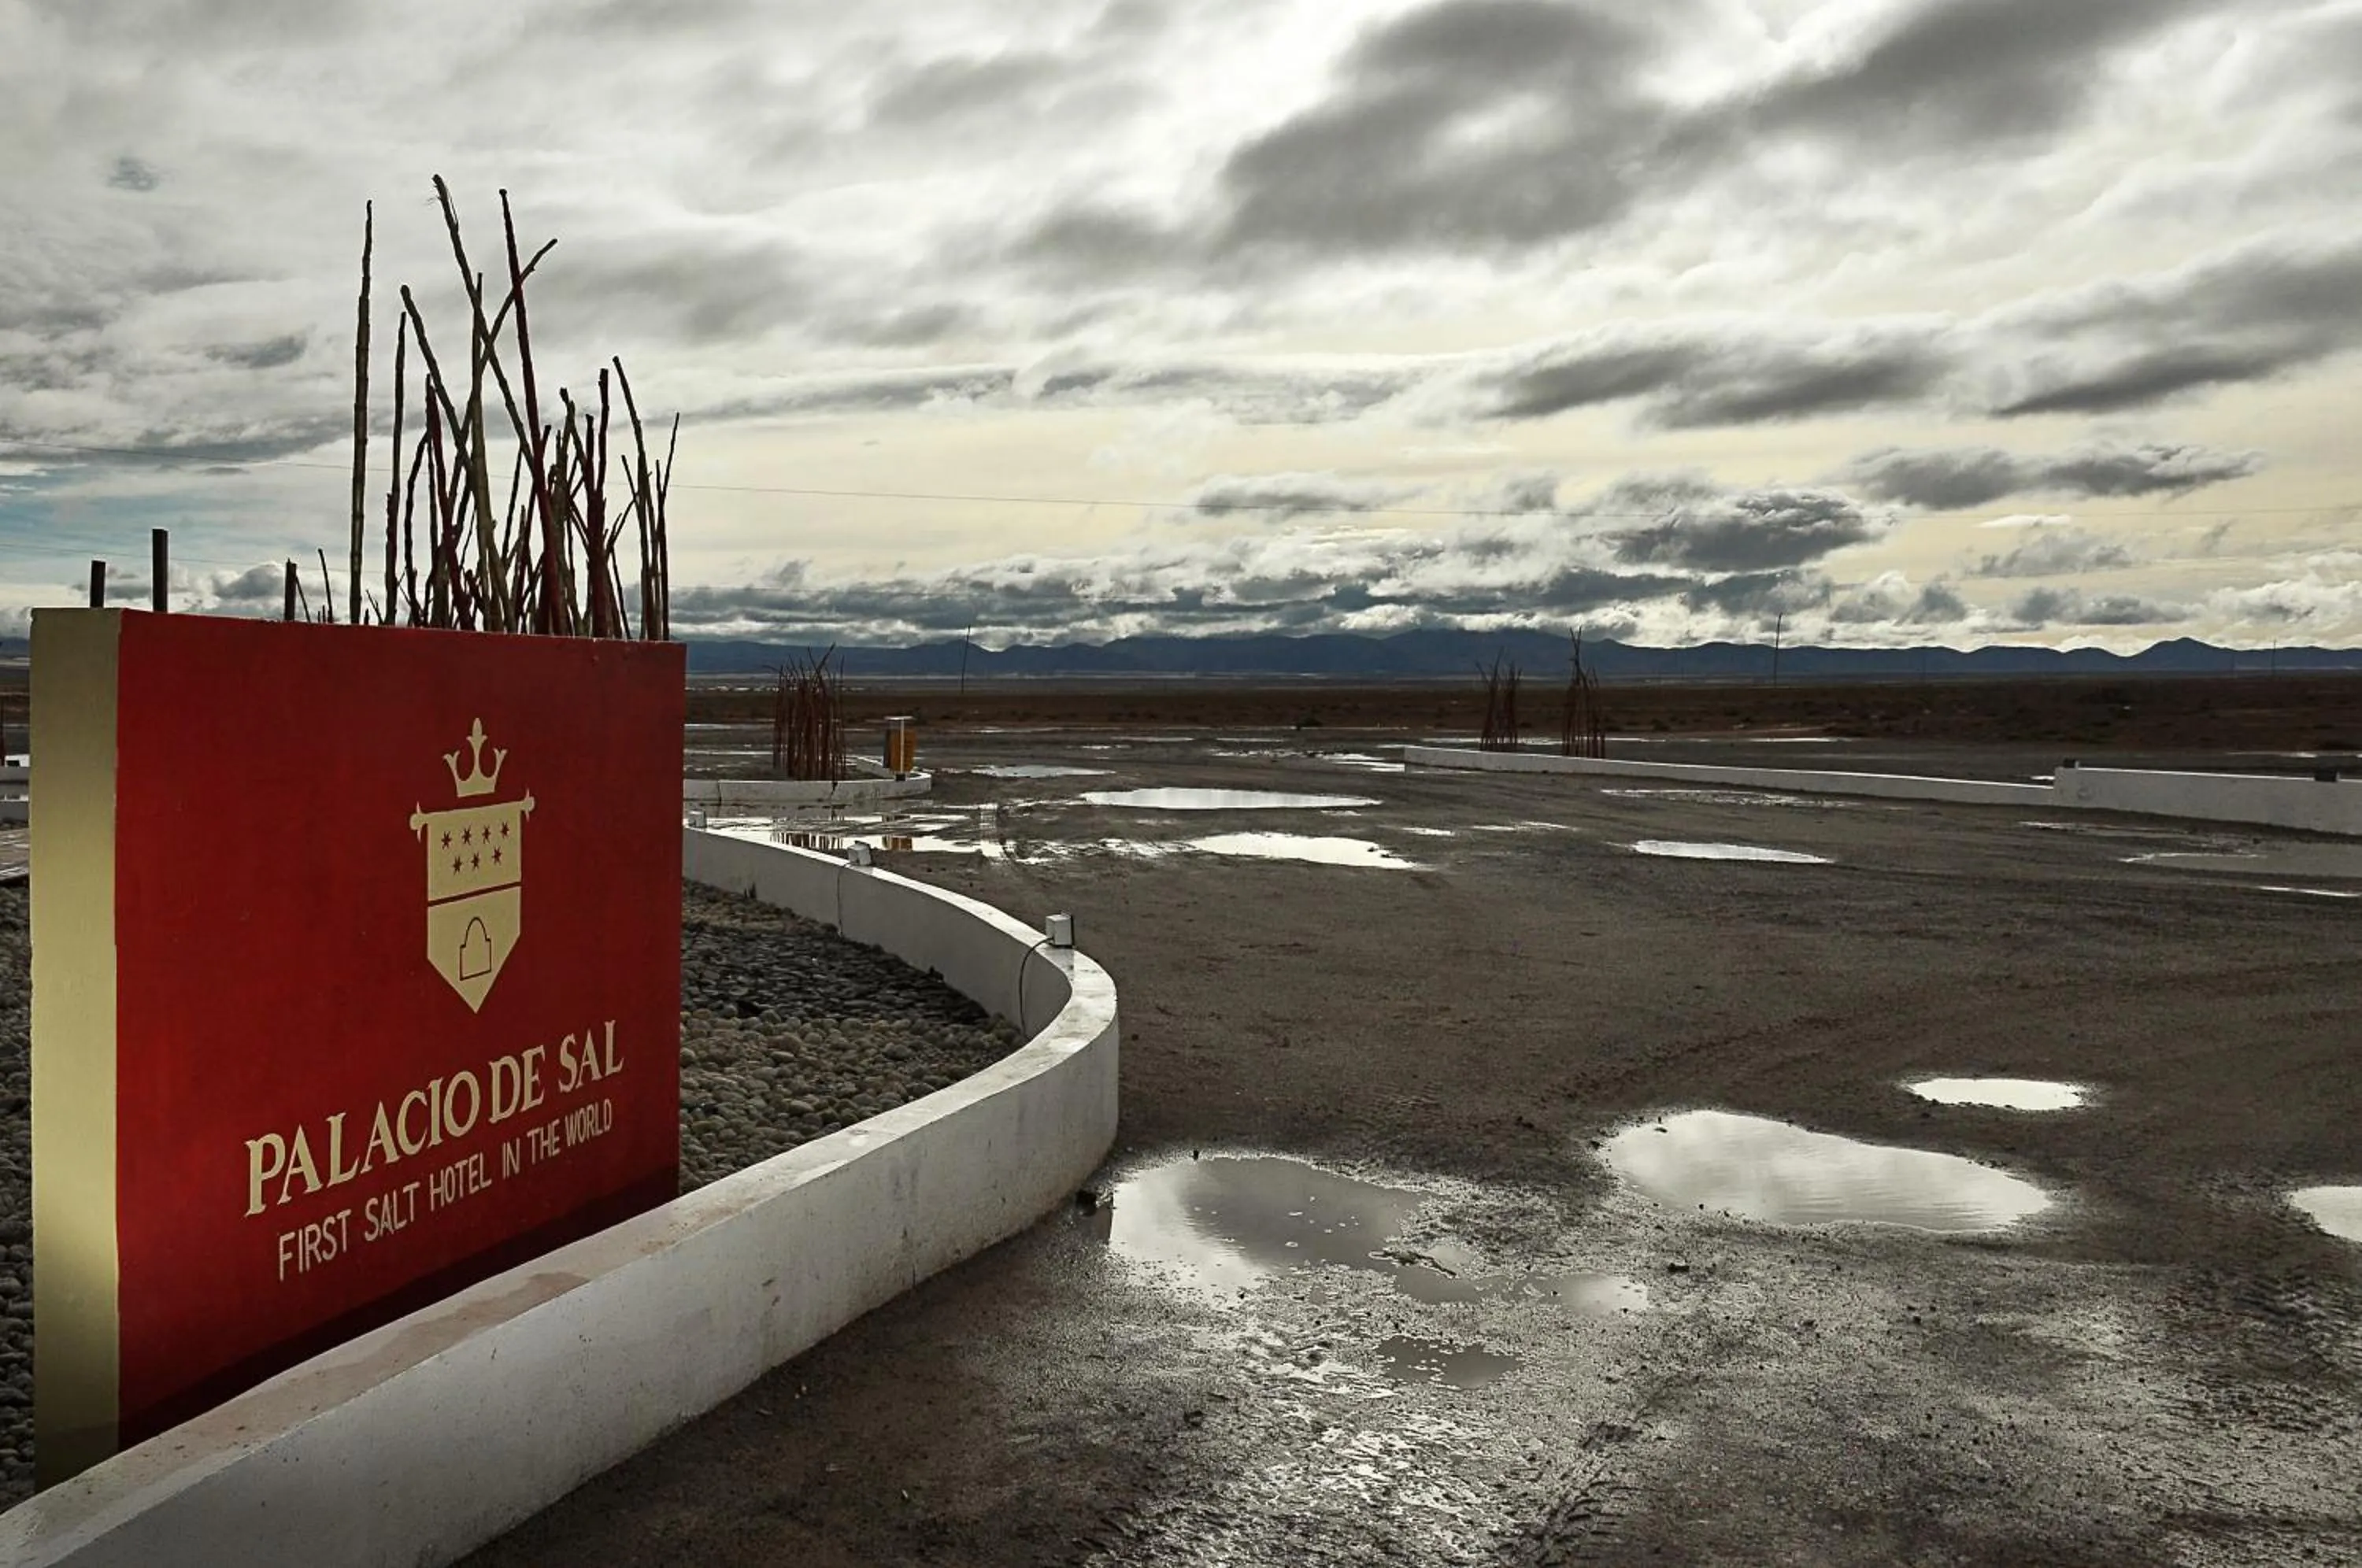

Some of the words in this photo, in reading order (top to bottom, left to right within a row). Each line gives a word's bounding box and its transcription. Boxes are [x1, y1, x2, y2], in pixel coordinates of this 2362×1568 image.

[244, 1070, 481, 1218] PALACIO
[488, 1045, 546, 1124] DE
[557, 1019, 624, 1093] SAL
[278, 1208, 353, 1281] FIRST
[364, 1181, 420, 1242] SALT
[429, 1152, 493, 1212] HOTEL
[502, 1141, 520, 1179] IN
[526, 1119, 561, 1165] THE
[564, 1098, 613, 1148] WORLD
